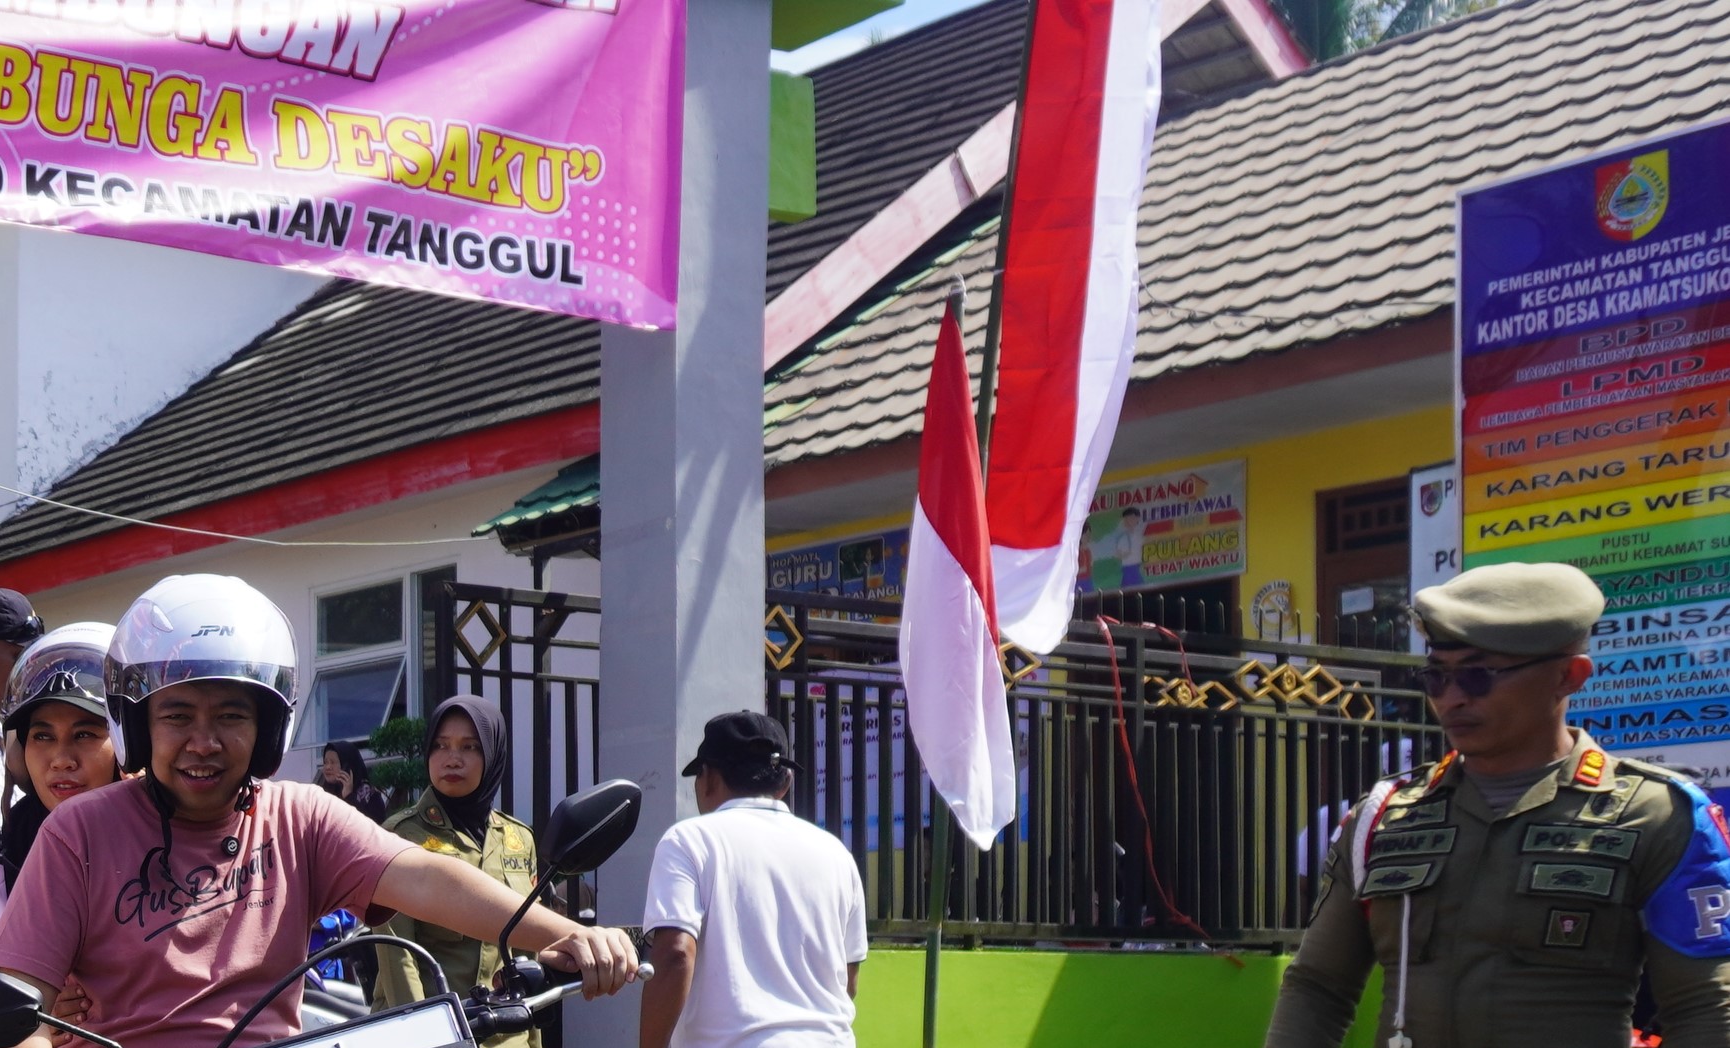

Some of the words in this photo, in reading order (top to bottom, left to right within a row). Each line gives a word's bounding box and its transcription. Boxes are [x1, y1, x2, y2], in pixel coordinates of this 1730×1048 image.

[24, 165, 352, 248] KECAMATAN
[366, 211, 584, 286] TANGGUL
[1487, 258, 1595, 296] PEMERINTAH
[1601, 231, 1706, 269] KABUPATEN
[1520, 266, 1643, 310] KECAMATAN
[1477, 314, 1548, 345] KANTOR
[1553, 303, 1600, 329] DESA
[1580, 317, 1686, 354] BPD
[1561, 356, 1706, 398] LPMD
[1480, 406, 1542, 429] LEMBAGA
[1544, 385, 1653, 417] PEMBERDAYAAN
[1484, 438, 1527, 459] TIM
[1535, 401, 1718, 450] PENGGERAK
[1118, 479, 1196, 507] DATANG
[1486, 460, 1627, 498] KARANG
[1479, 500, 1632, 539] KARANG
[1142, 530, 1240, 564] PULANG
[1601, 532, 1650, 550] PUSTU
[1633, 540, 1706, 561] KERAMAT
[772, 560, 833, 588] GURU
[1145, 560, 1185, 577] TEPAT
[1189, 551, 1240, 569] WAKTU
[191, 625, 235, 638] JPN
[1598, 626, 1699, 651] PEMBINA
[1592, 673, 1662, 692] PEMBINA
